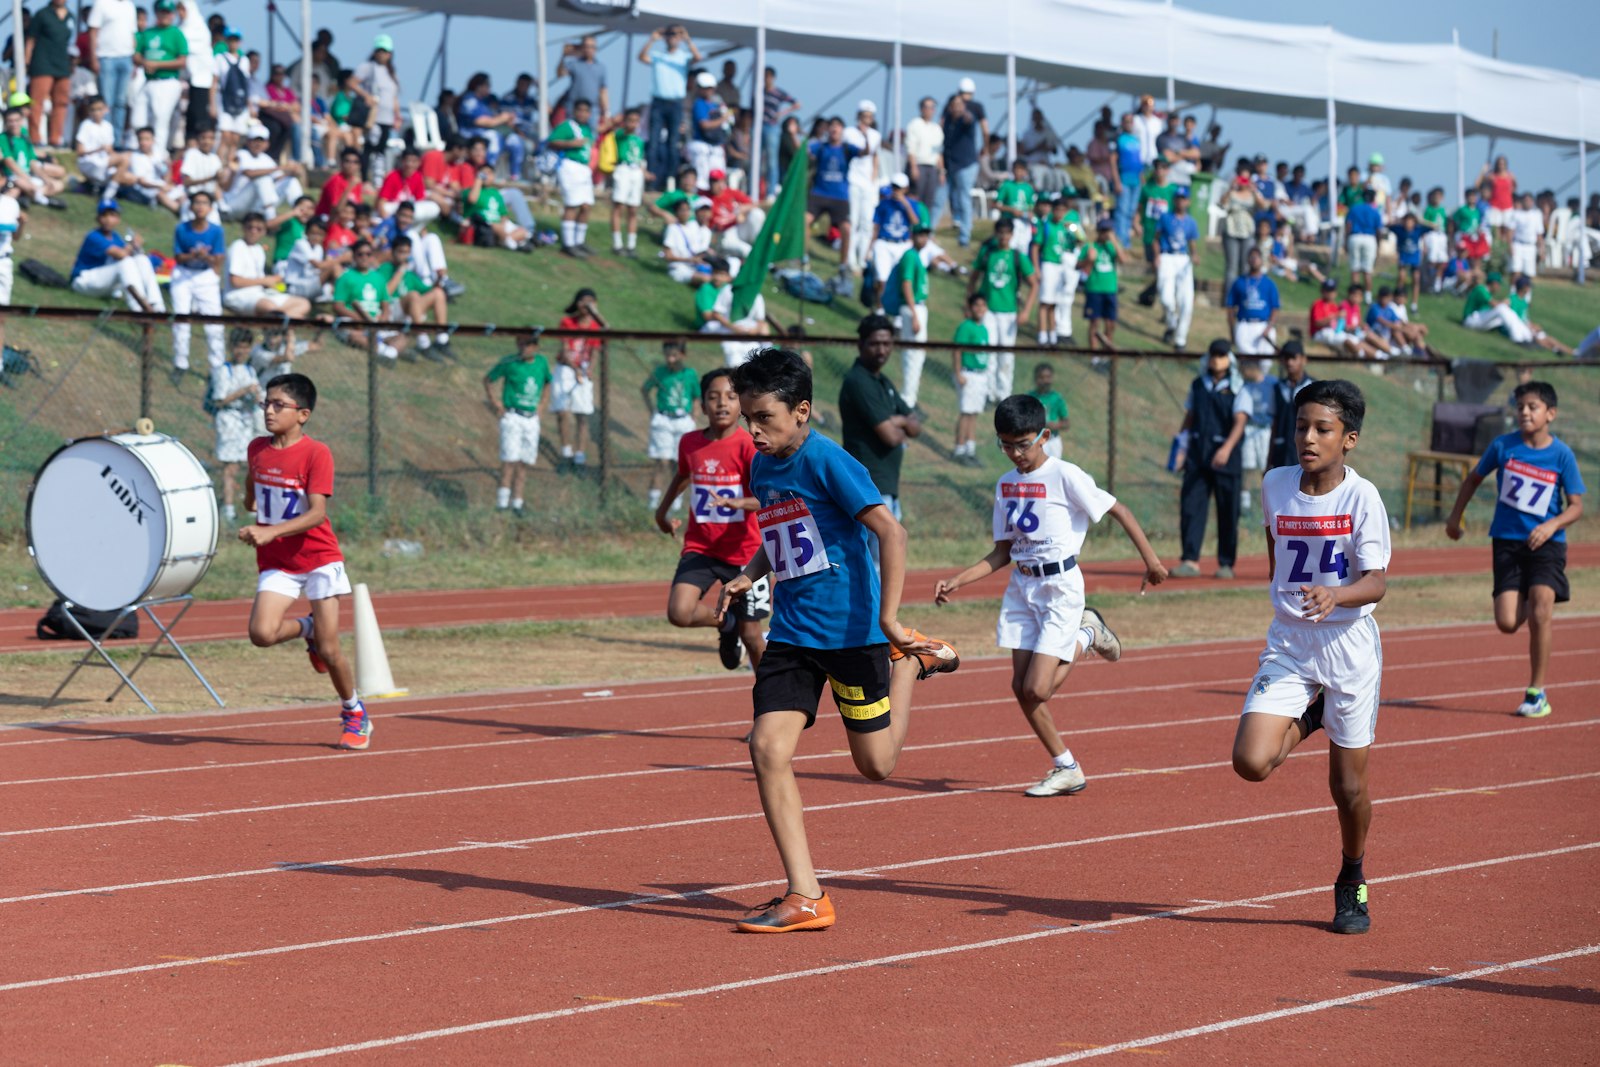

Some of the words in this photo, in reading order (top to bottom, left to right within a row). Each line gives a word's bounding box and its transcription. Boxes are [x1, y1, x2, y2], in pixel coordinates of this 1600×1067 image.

[262, 487, 300, 519] 12
[695, 488, 737, 516] 28
[1506, 475, 1547, 507] 27
[1005, 500, 1039, 533] 26
[1285, 521, 1302, 529] MARY'S
[764, 522, 814, 573] 25
[1287, 540, 1349, 582] 24
